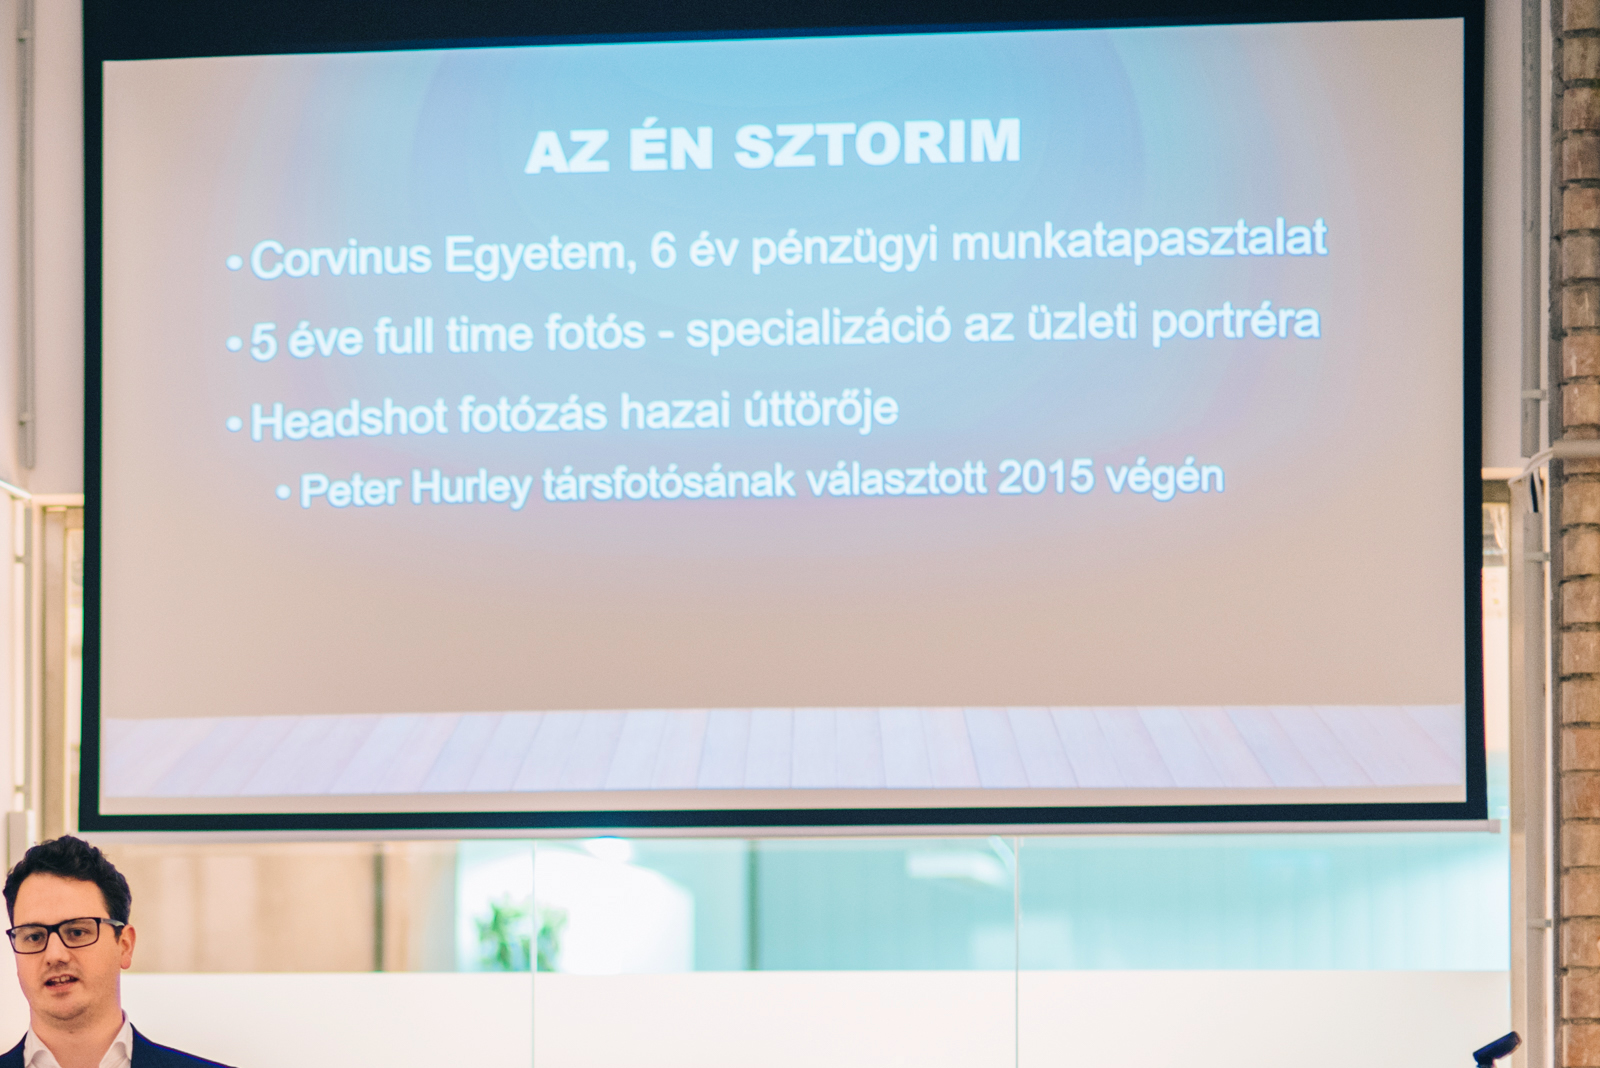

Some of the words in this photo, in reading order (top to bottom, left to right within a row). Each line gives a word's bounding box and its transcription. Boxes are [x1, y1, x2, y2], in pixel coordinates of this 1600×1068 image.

[523, 128, 611, 176] AZ
[628, 115, 714, 173] ÉN
[733, 116, 1022, 170] SZTORIM
[252, 237, 433, 279] Corvinus
[444, 233, 638, 283] Egyetem,
[649, 229, 678, 270] 6
[688, 229, 741, 268] év
[751, 222, 939, 276] pénzügyi
[951, 216, 1328, 267] munkatapasztalat
[252, 323, 276, 360] 5
[289, 320, 364, 358] éve
[373, 315, 434, 355] full
[444, 314, 535, 354] time
[543, 311, 647, 352] fotós
[685, 304, 953, 358] specializáció
[963, 311, 1016, 343] az
[1027, 300, 1138, 341] üzleti
[1151, 300, 1319, 349] portréra
[254, 397, 449, 440] Headshot
[457, 393, 608, 434] fotózás
[620, 389, 731, 431] hazai
[743, 386, 900, 436] úttörője
[302, 474, 402, 507] Peter
[413, 468, 533, 509] Hurley
[542, 461, 796, 501] társfotósának
[805, 460, 988, 496] választott
[998, 458, 1094, 493] 2015
[1105, 457, 1223, 500] végén
